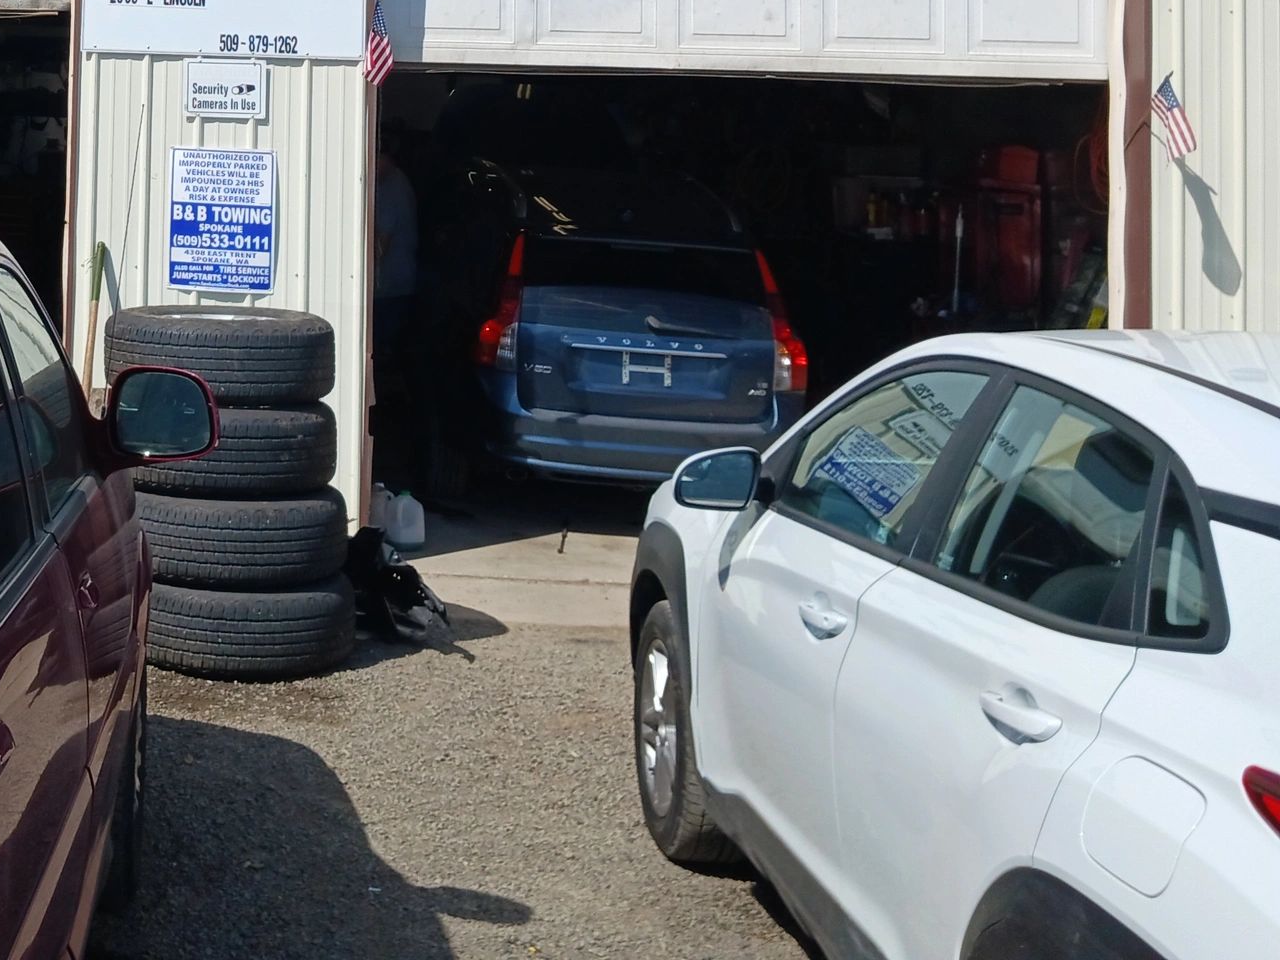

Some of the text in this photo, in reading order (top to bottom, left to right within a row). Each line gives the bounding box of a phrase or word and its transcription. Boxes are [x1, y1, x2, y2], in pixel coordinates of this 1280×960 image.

[192, 82, 229, 98] Security
[192, 97, 256, 110] Cameras In Use
[183, 152, 250, 161] UNAUTHORIZED
[179, 160, 268, 171] IMPROPERLY PARKED
[186, 169, 226, 177] VEHICLES
[227, 170, 247, 178] WILL
[181, 177, 233, 186] IMPOUNDED
[223, 187, 261, 195] OWNERS
[218, 195, 256, 203] EXPENSE
[212, 206, 272, 225] TOWING
[198, 223, 243, 233] SPOKANE
[230, 251, 257, 259] TRENT
[219, 266, 237, 274] TIRE
[237, 267, 270, 276] SERVICE
[172, 271, 270, 284] JUMPSTARTS LOCKOUTS
[596, 336, 703, 351] VOLVO
